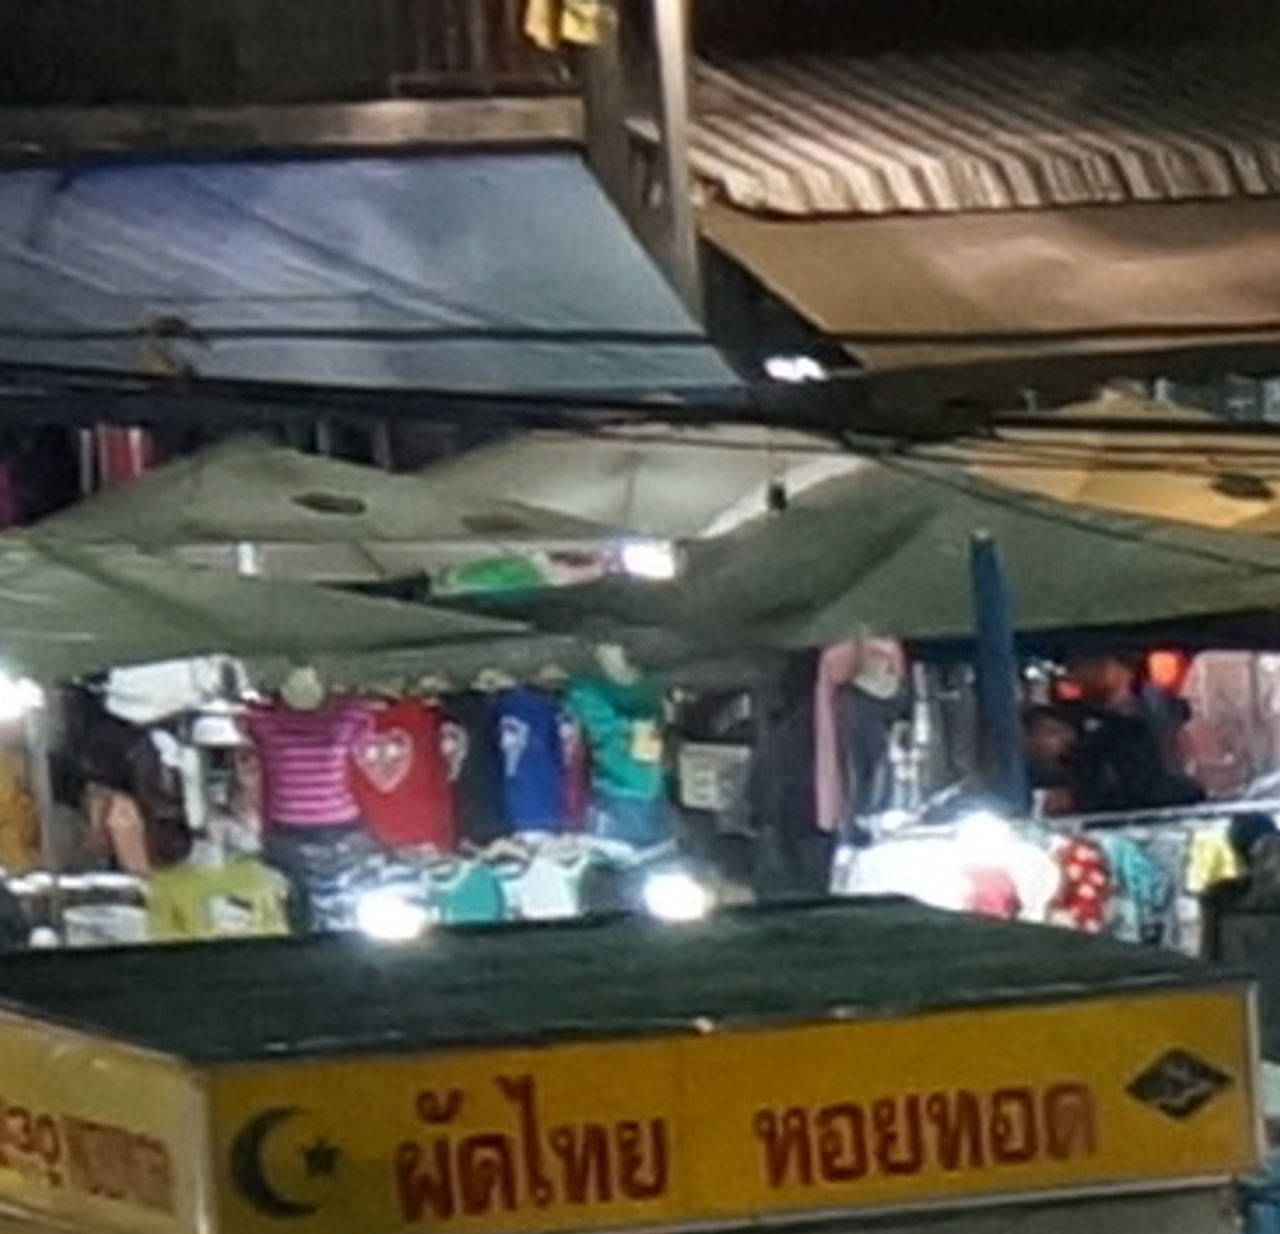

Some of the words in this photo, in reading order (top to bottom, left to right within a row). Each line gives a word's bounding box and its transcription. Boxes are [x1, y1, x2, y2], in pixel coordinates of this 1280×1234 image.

[395, 1073, 668, 1221] ผัดไทย
[753, 1082, 1097, 1189] หอยทอด
